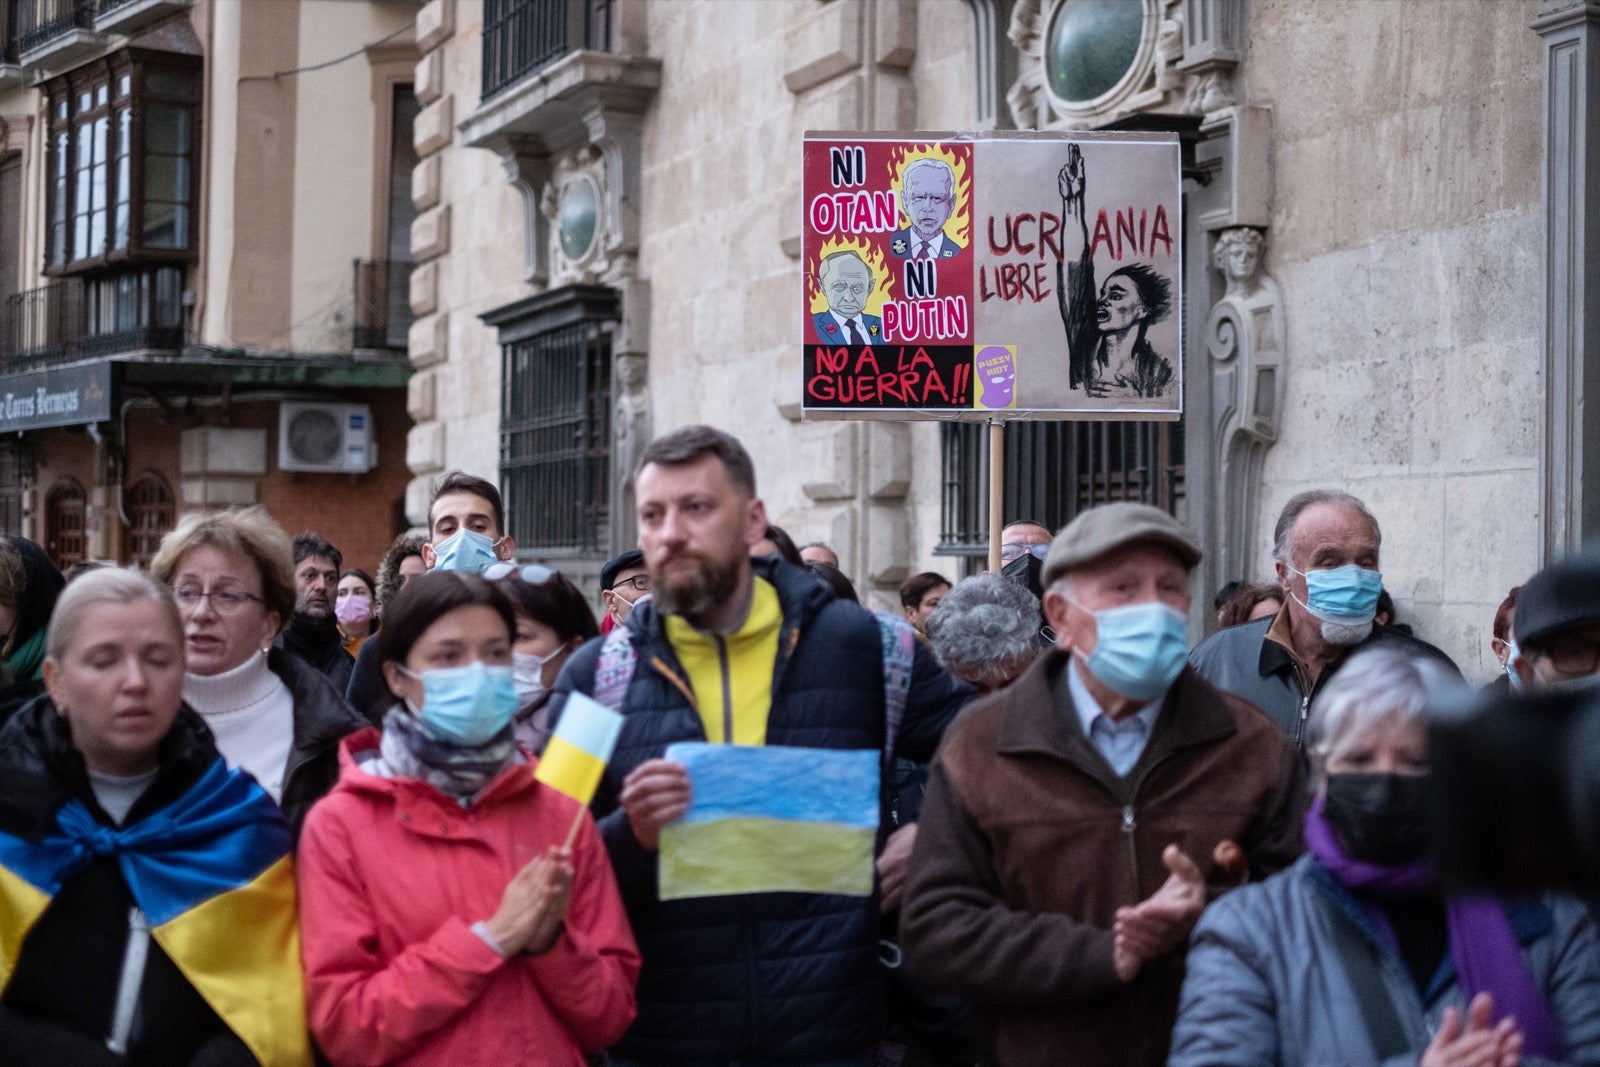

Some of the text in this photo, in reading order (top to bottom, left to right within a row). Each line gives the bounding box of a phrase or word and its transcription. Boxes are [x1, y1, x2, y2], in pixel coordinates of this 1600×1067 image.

[831, 147, 865, 187] NI
[812, 191, 897, 234] OTAN
[905, 259, 936, 298] NI
[979, 262, 1051, 304] LIBRE
[882, 296, 967, 341] PUTIN
[816, 345, 934, 375] NO A LA
[978, 354, 1011, 369] PUSSY
[986, 364, 1009, 376] RIOT
[807, 362, 971, 406] GUERRA!!
